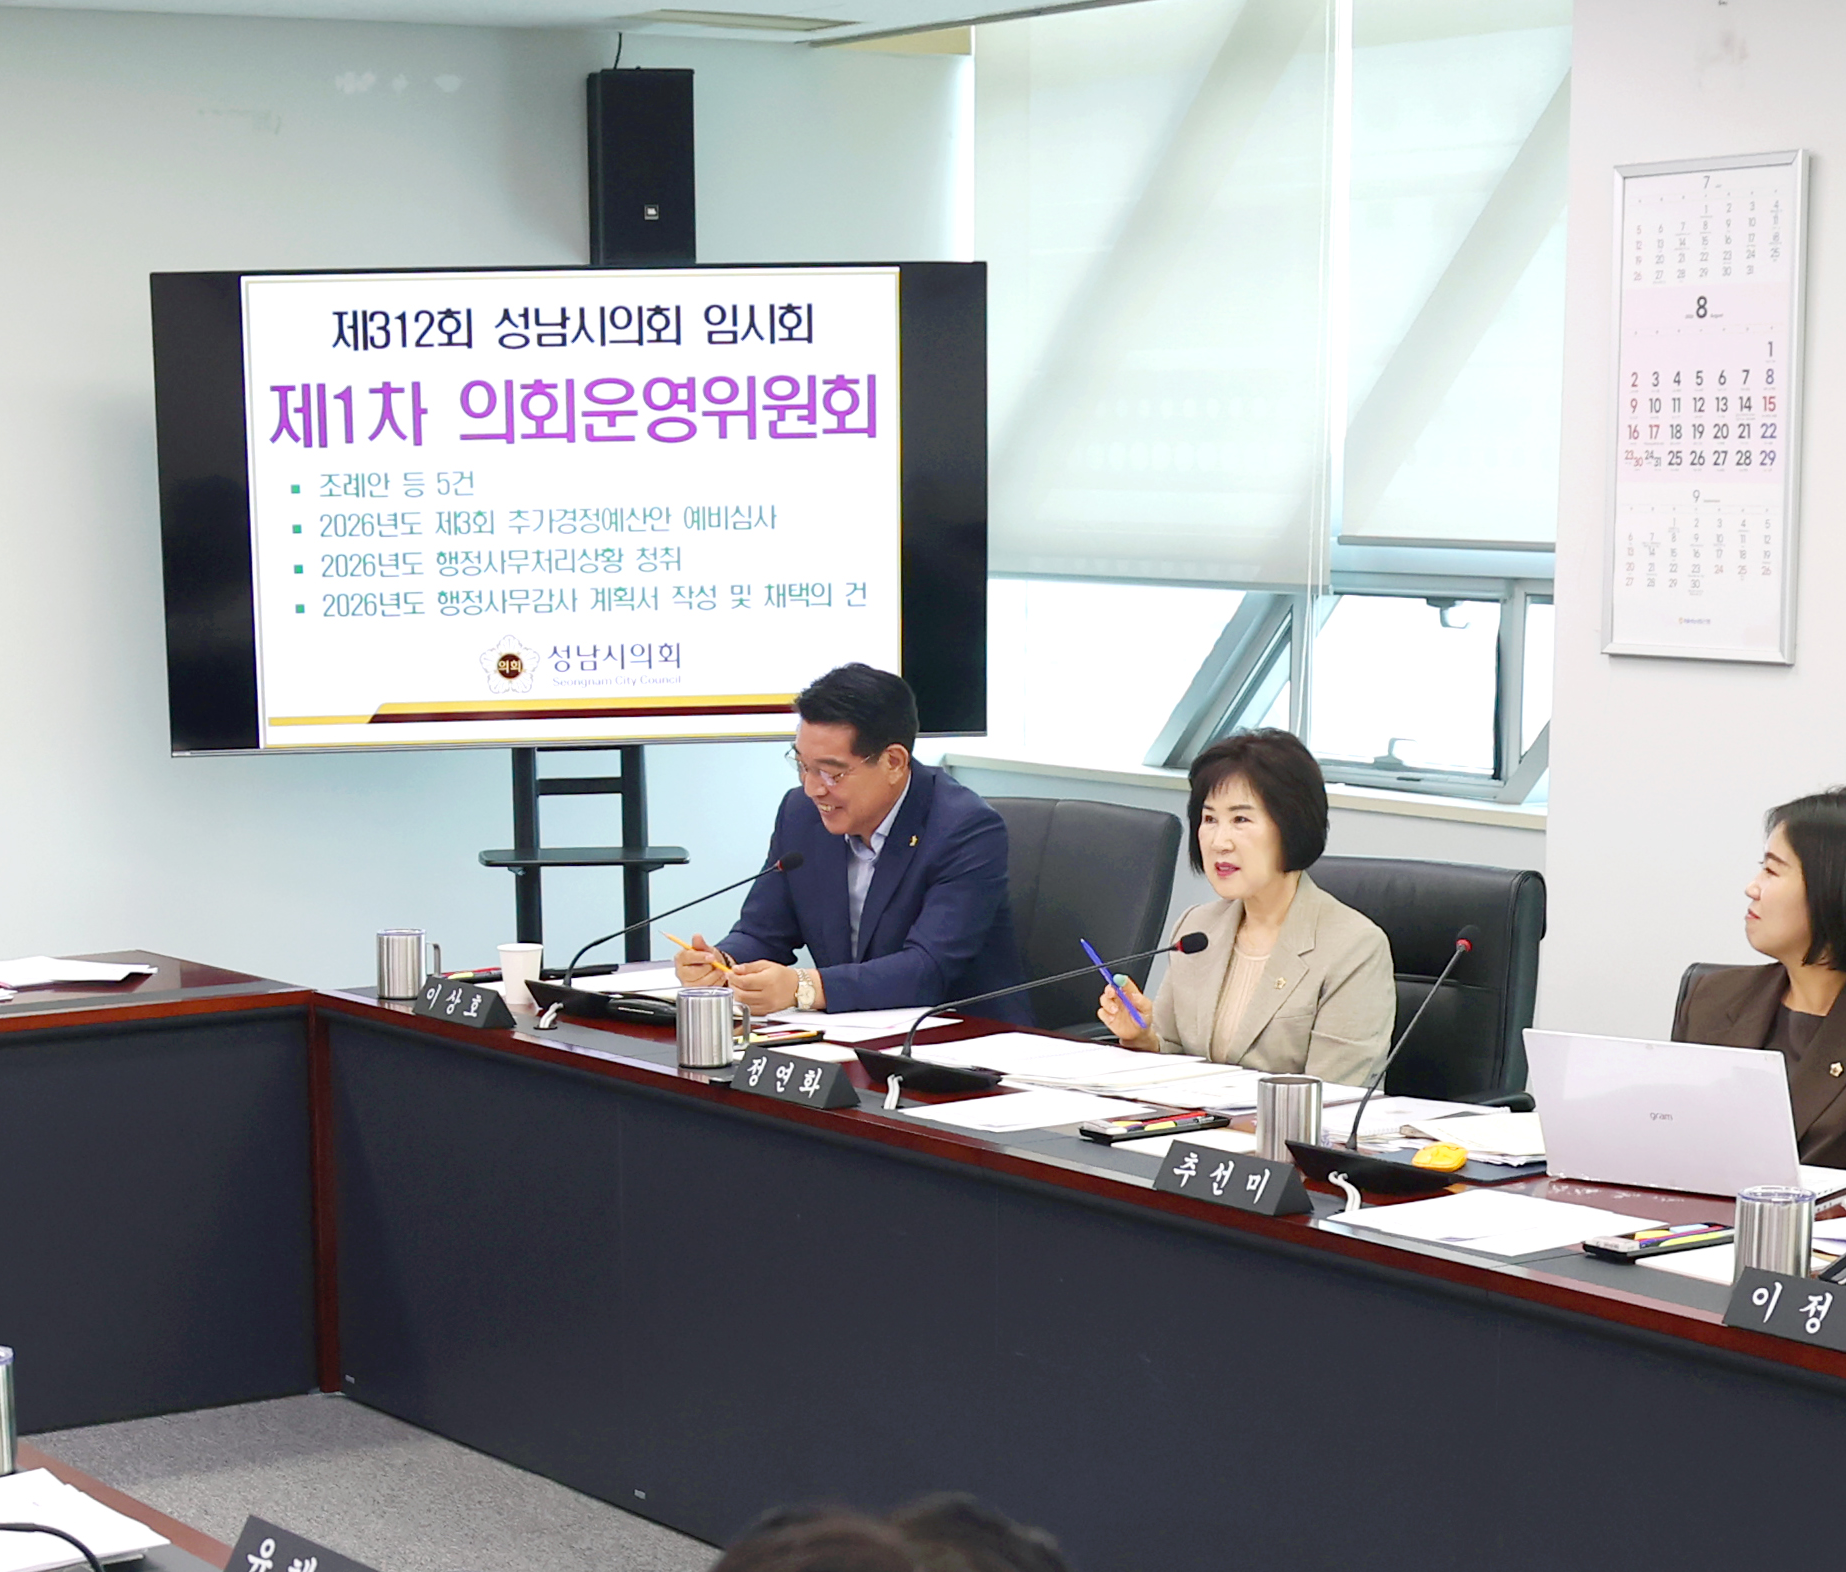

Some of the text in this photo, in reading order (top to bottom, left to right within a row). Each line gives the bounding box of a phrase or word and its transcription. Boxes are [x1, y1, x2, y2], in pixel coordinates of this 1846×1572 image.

[1703, 176, 1710, 189] 7
[1696, 296, 1707, 318] 8
[331, 302, 813, 351] 제312회 성남시의회 임시회
[1631, 369, 1774, 387] 2 3 4 5 6 7 8
[269, 374, 877, 448] 제1차 의회운영위원회
[1630, 397, 1776, 413] 9 10 11 12 13 14 15
[1628, 423, 1777, 439] 16 17 18 19 20 21 22
[1668, 451, 1682, 466] 25
[1690, 451, 1705, 466] 26
[1713, 451, 1728, 466] 27
[1736, 451, 1752, 466] 28
[1759, 451, 1776, 466] 29
[319, 470, 474, 499] 조례안 등 5건
[1693, 490, 1700, 503] 9
[319, 504, 778, 538] 2026년도 제3회 추가경정예산안 예비심사
[321, 546, 681, 578] 2026년도 행정사무처리상황 청취
[322, 581, 867, 618] 2026년도 행정사무감사 계획서 작성 및 채택의 건
[498, 659, 523, 674] 의회
[548, 642, 681, 673] 성남시의회
[553, 674, 681, 689] Seongnam City Council
[745, 1056, 824, 1100] 정연화
[1649, 1112, 1674, 1121] gram
[1172, 1151, 1273, 1205] 추선미
